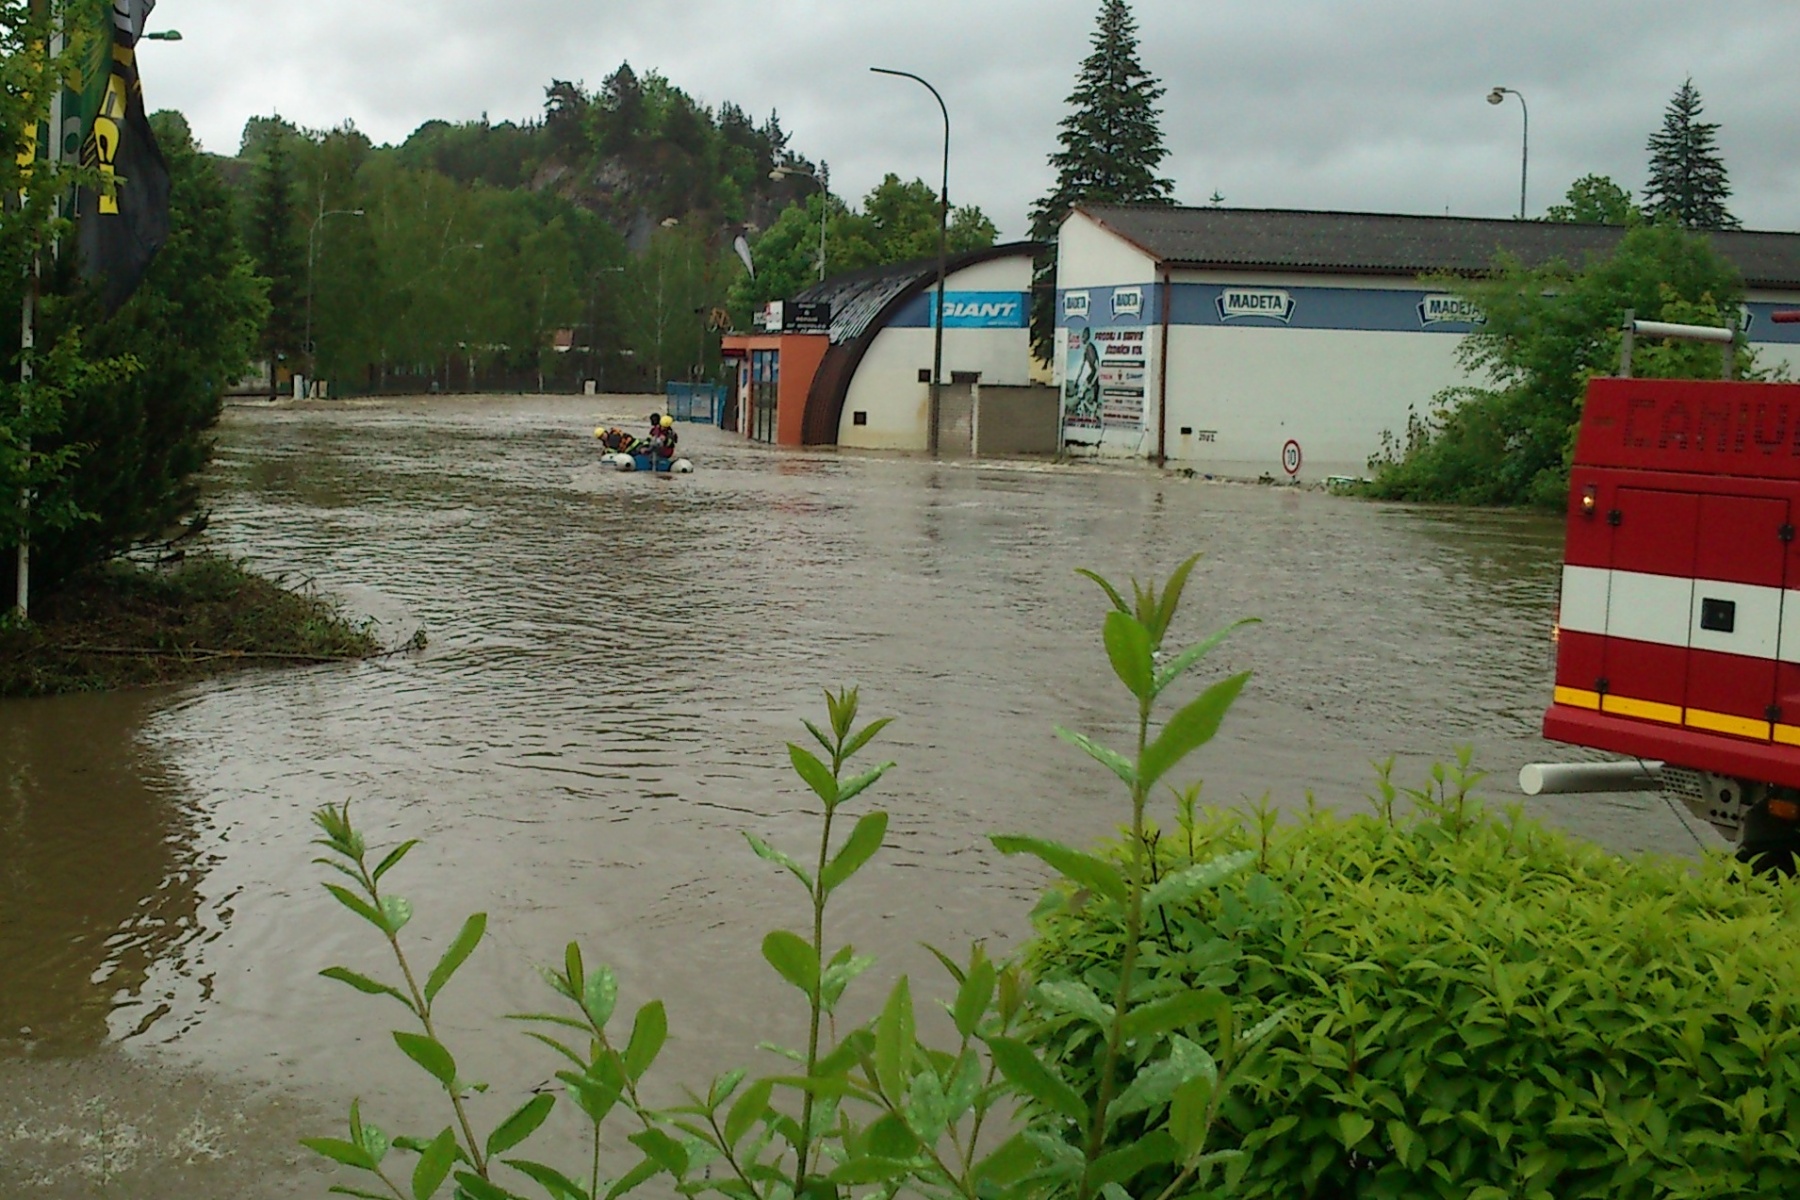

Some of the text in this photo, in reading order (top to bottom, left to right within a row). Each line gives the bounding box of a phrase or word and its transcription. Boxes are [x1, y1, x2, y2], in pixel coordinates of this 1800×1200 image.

[935, 302, 1017, 317] GIANT
[1228, 294, 1282, 310] MADETA
[1287, 449, 1297, 466] 10
